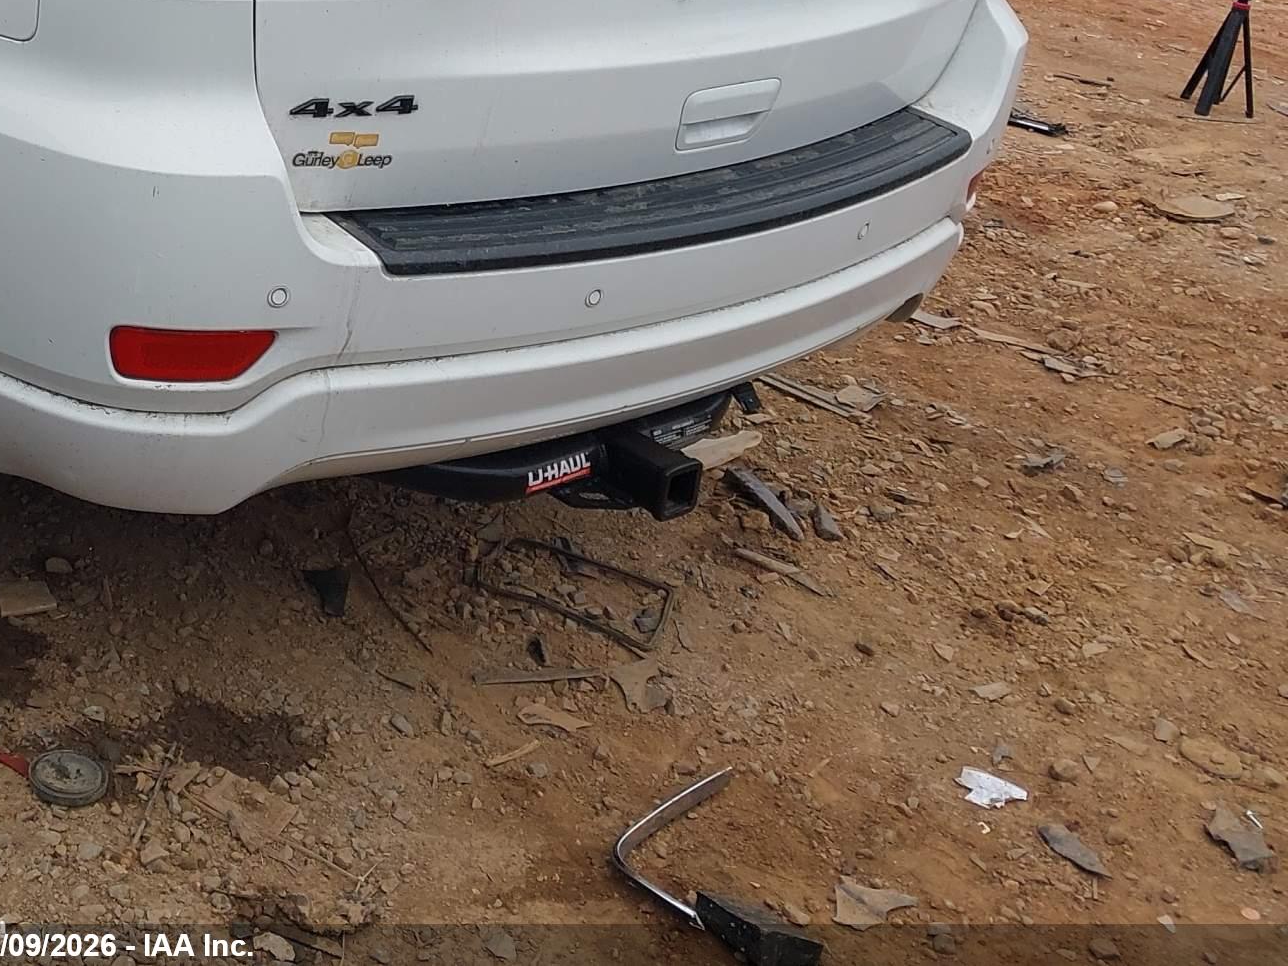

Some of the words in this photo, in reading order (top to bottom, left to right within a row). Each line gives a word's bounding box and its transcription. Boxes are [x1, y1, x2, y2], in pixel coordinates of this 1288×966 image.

[289, 95, 418, 118] 4x4
[292, 151, 340, 169] Gurley
[357, 153, 393, 169] Leep
[528, 452, 591, 487] U-HAUL
